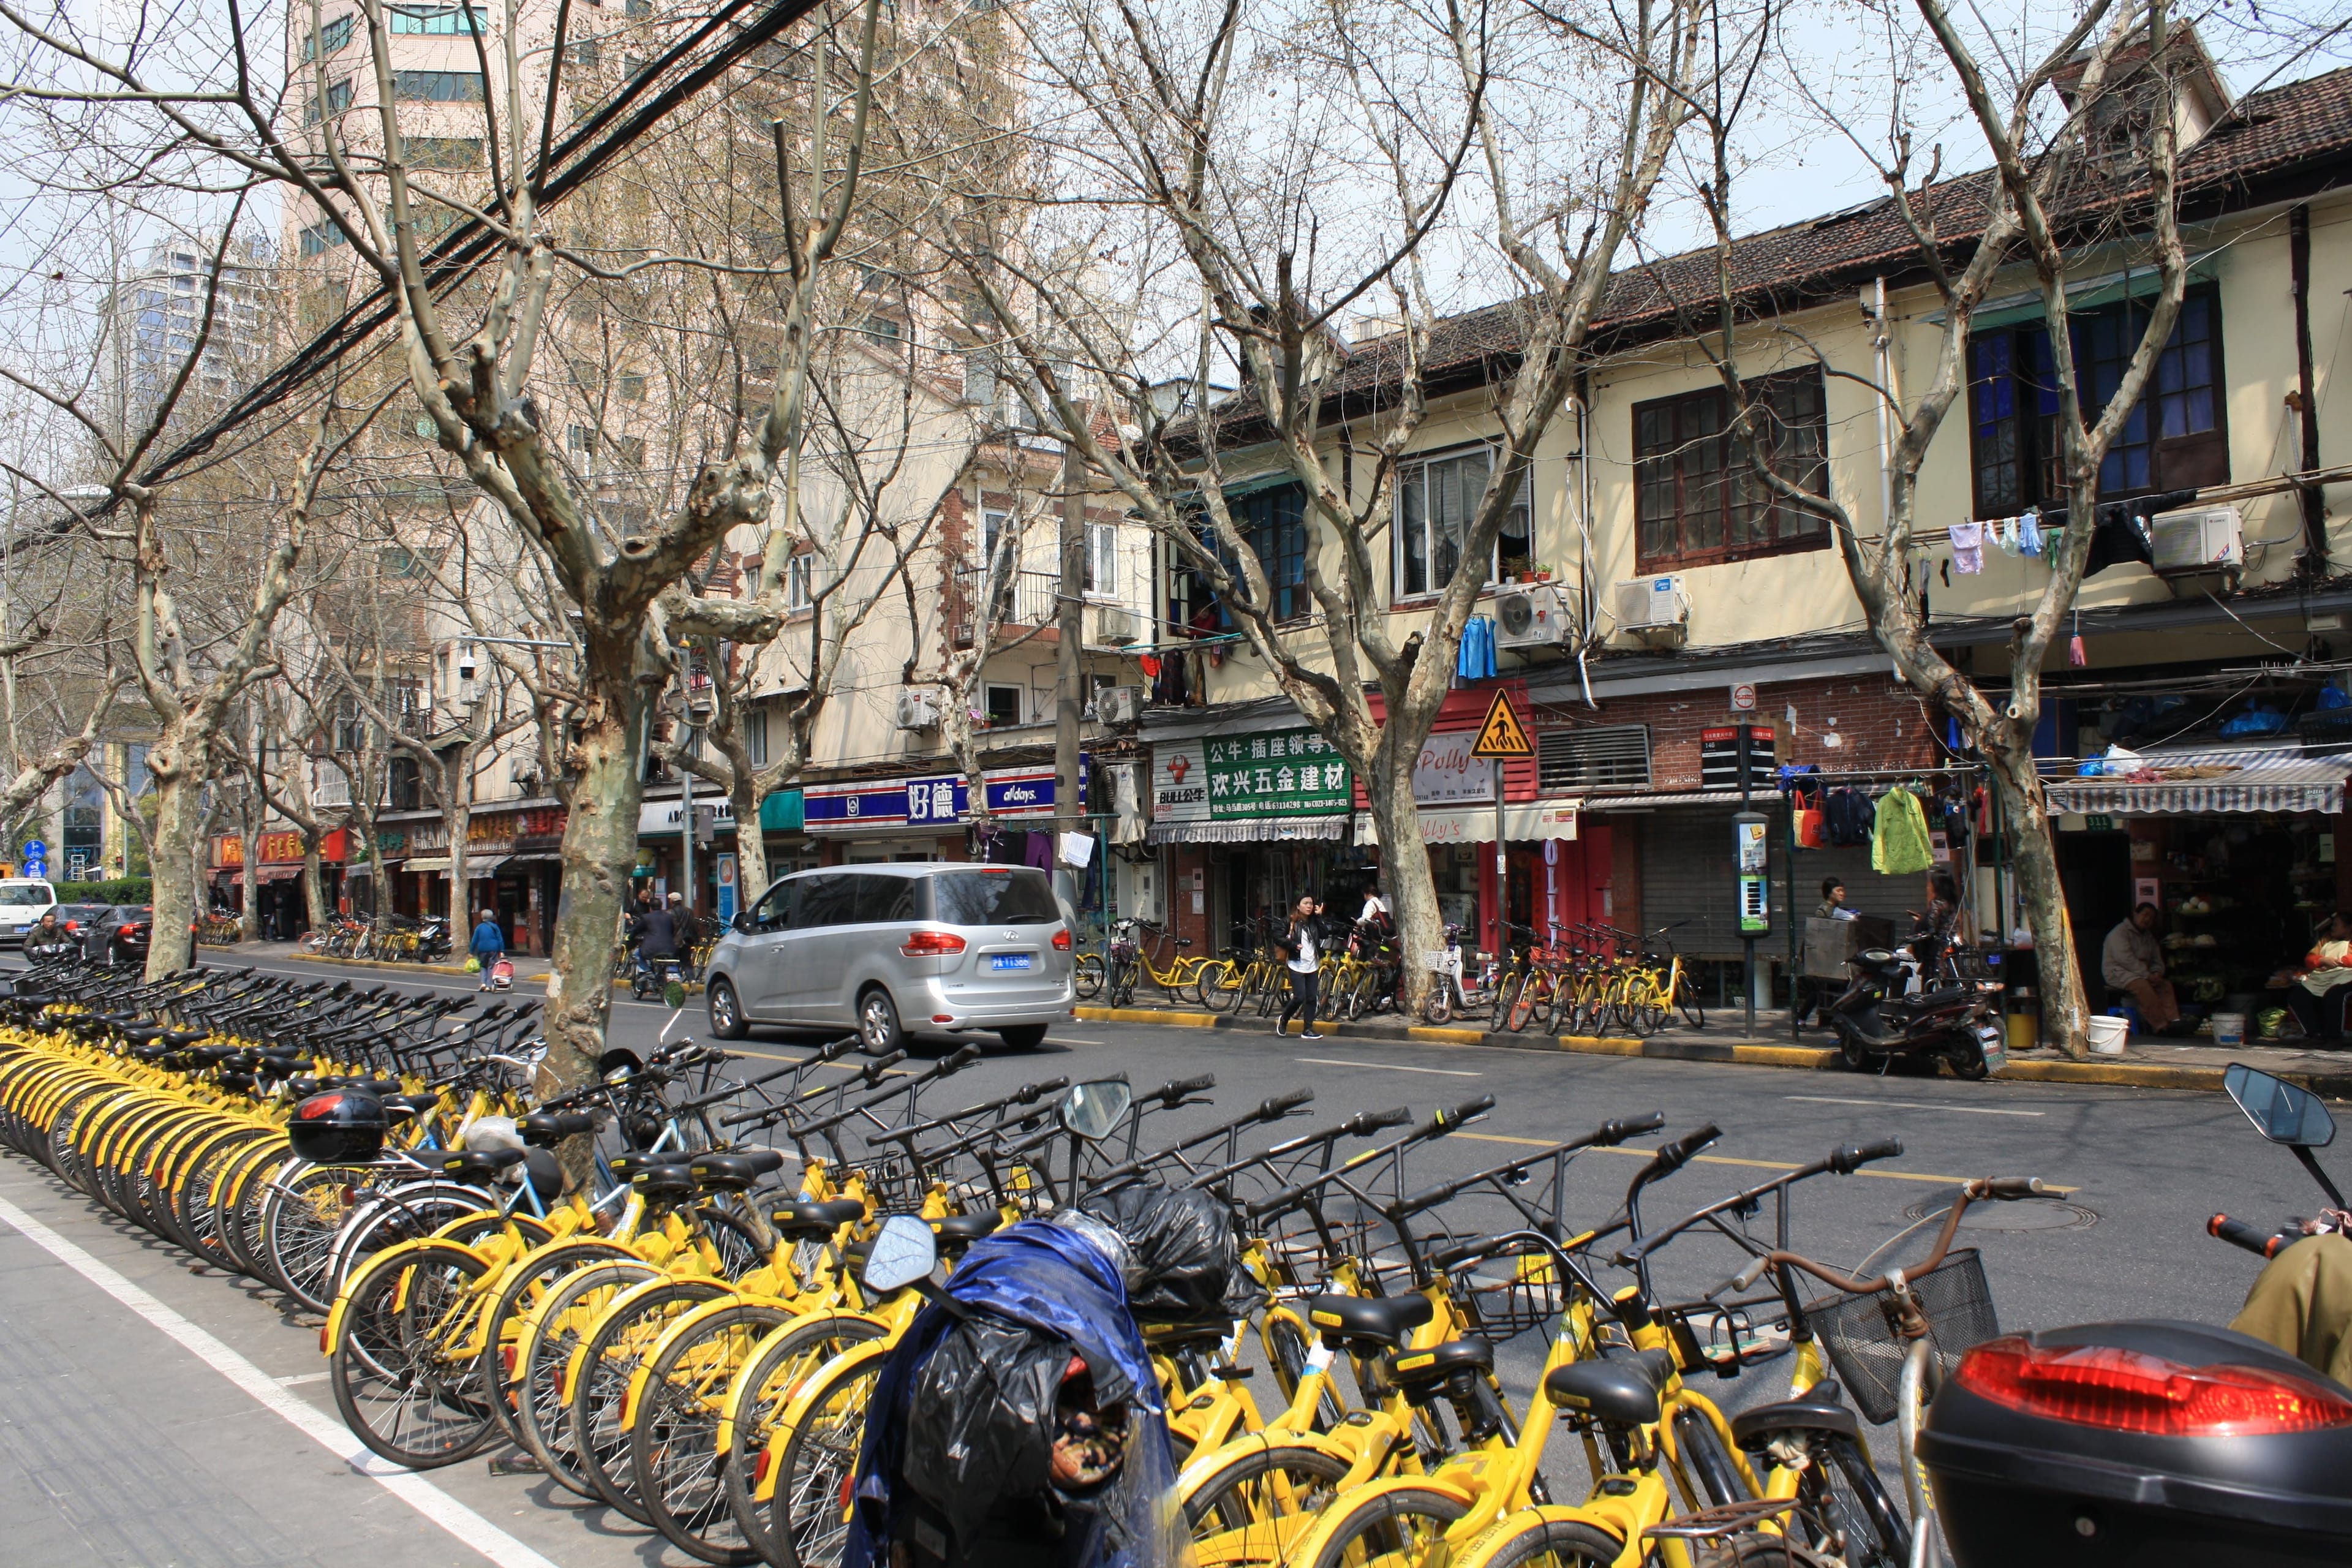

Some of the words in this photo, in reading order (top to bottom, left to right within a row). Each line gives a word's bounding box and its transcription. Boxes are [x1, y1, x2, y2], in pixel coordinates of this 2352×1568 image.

[1212, 763, 1345, 797] 欢兴五金建材
[2088, 816, 2109, 826] 311
